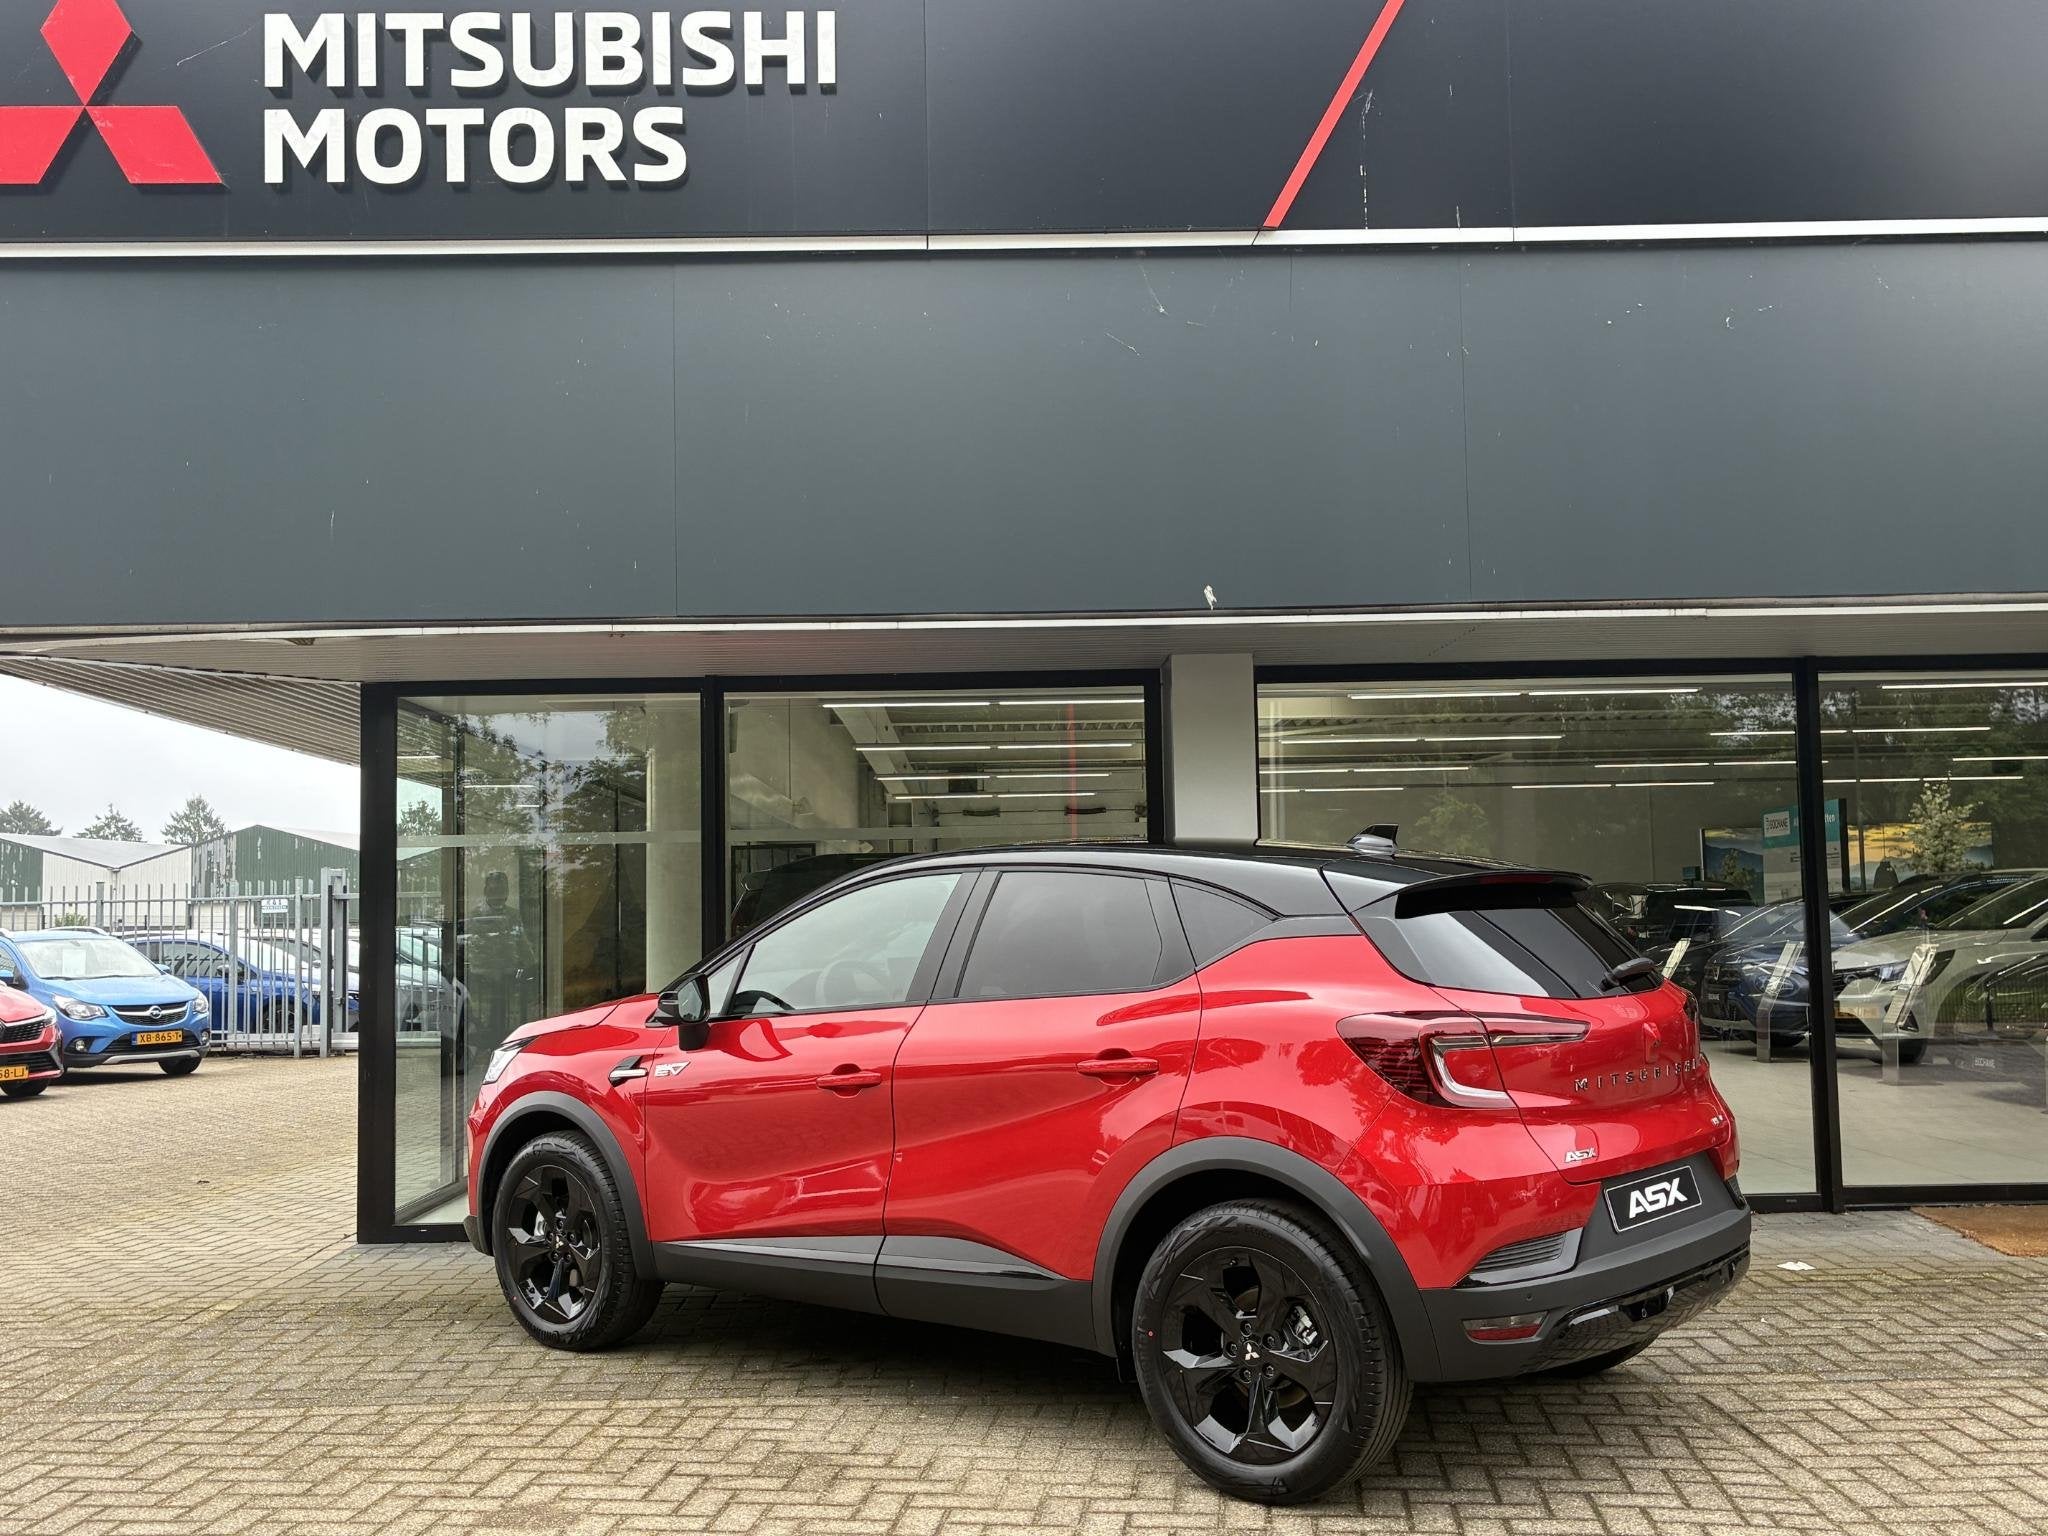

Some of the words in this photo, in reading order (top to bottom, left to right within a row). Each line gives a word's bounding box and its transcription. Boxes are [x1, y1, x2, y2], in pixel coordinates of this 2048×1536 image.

[264, 10, 836, 88] MITSUBISHI
[264, 106, 687, 185] MOTORS
[1574, 1058, 1697, 1092] MITSUBISHI
[1565, 1147, 1598, 1162] ASX
[1629, 1177, 1688, 1218] ASX
